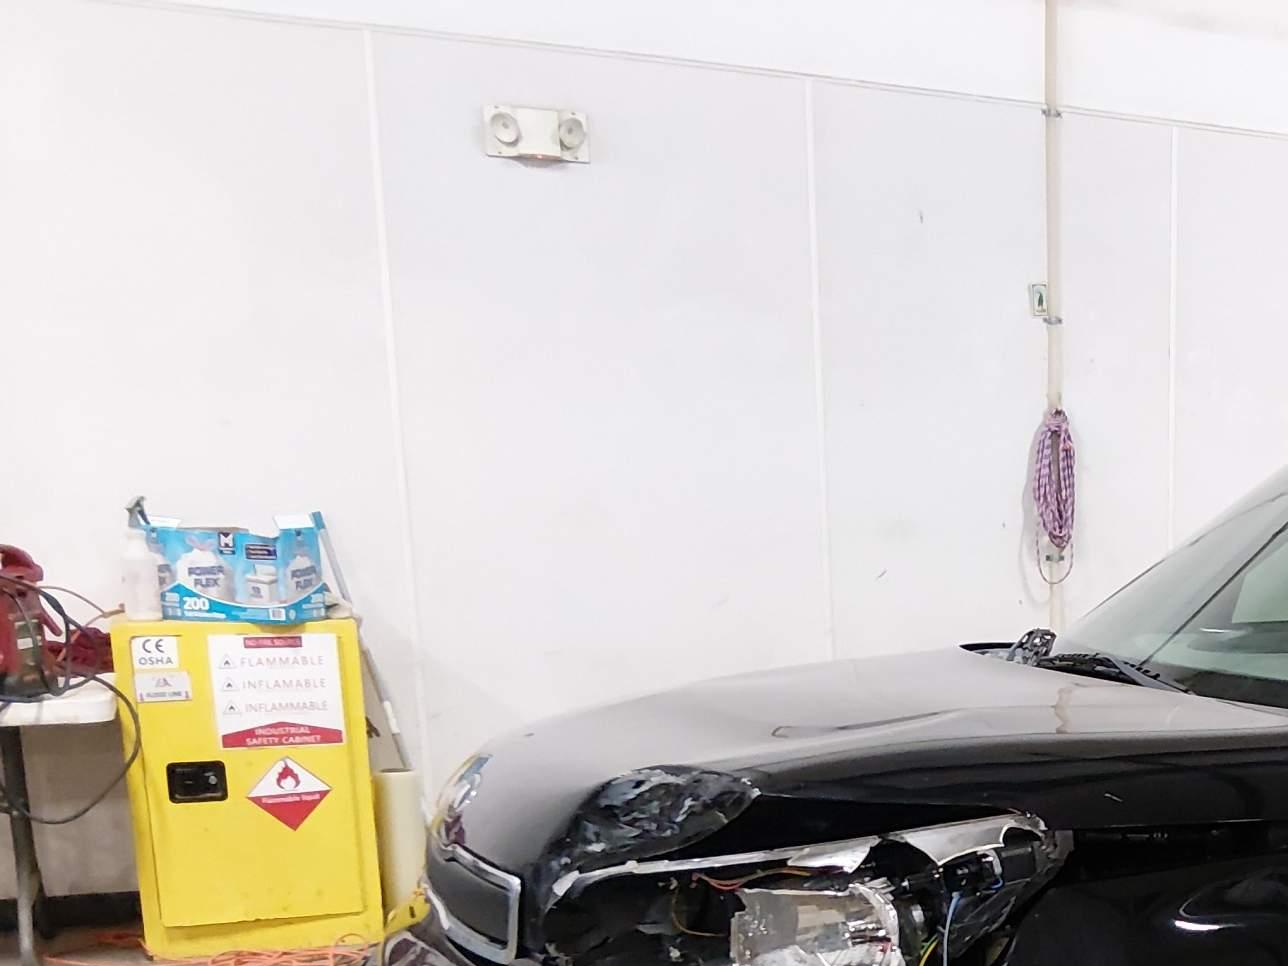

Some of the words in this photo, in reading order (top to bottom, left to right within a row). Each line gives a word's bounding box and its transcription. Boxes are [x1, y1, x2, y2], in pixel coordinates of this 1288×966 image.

[194, 577, 220, 587] FLEX
[183, 598, 210, 611] 200
[138, 656, 174, 666] OSHA
[240, 655, 325, 668] FLAMMABLE
[242, 678, 327, 690] INFLAMABLE
[245, 700, 329, 713] INFLAMMABLE
[255, 726, 310, 735] INDUSTRIAL
[245, 737, 279, 746] SAFETY
[282, 735, 321, 744] CABINET
